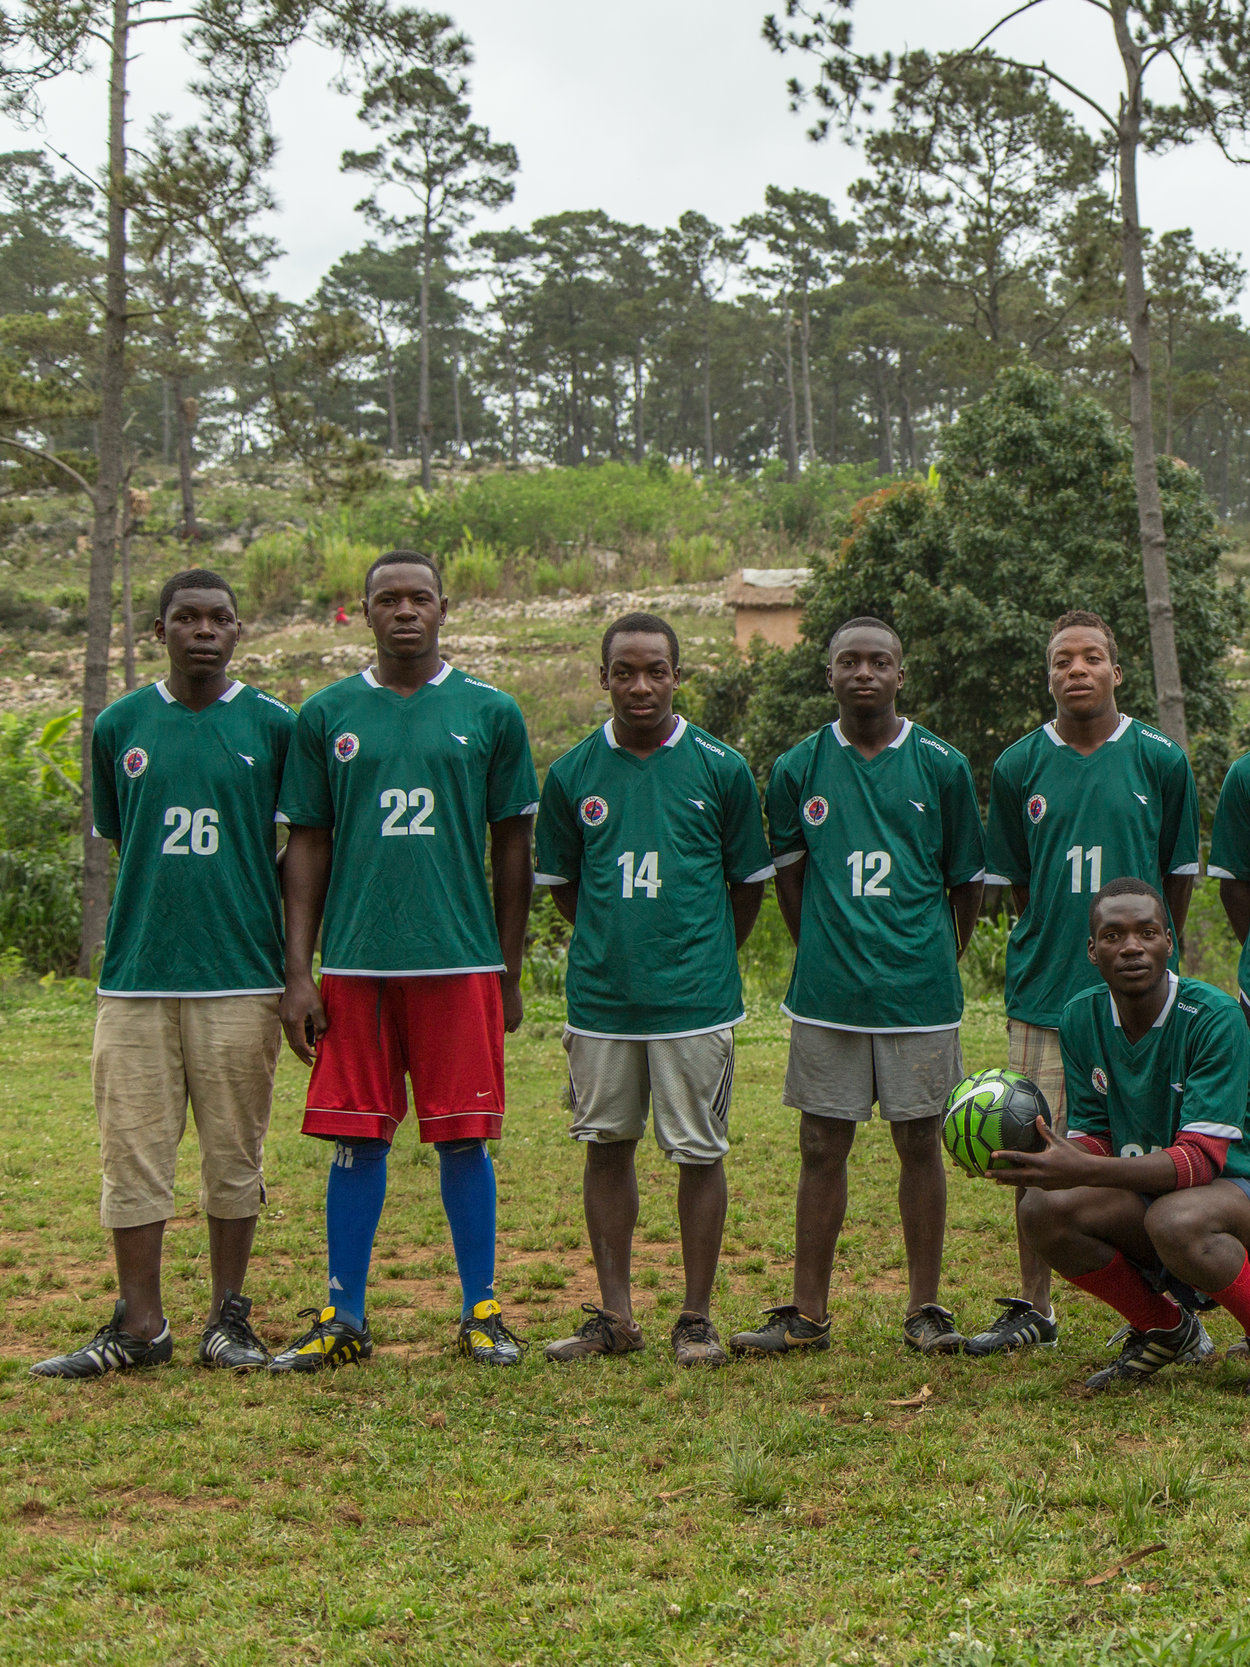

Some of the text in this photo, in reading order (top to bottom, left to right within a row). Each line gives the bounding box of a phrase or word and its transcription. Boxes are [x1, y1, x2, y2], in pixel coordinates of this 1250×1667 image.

[464, 677, 498, 693] DIADORA
[256, 693, 289, 713] DIADORA
[694, 736, 725, 757] DIADORA
[919, 737, 949, 757] DIADORA
[1141, 729, 1172, 748] DIADORA
[381, 788, 434, 836] 22
[163, 807, 218, 855] 26
[618, 852, 661, 899] 14
[847, 851, 891, 897] 12
[1066, 846, 1102, 893] 11
